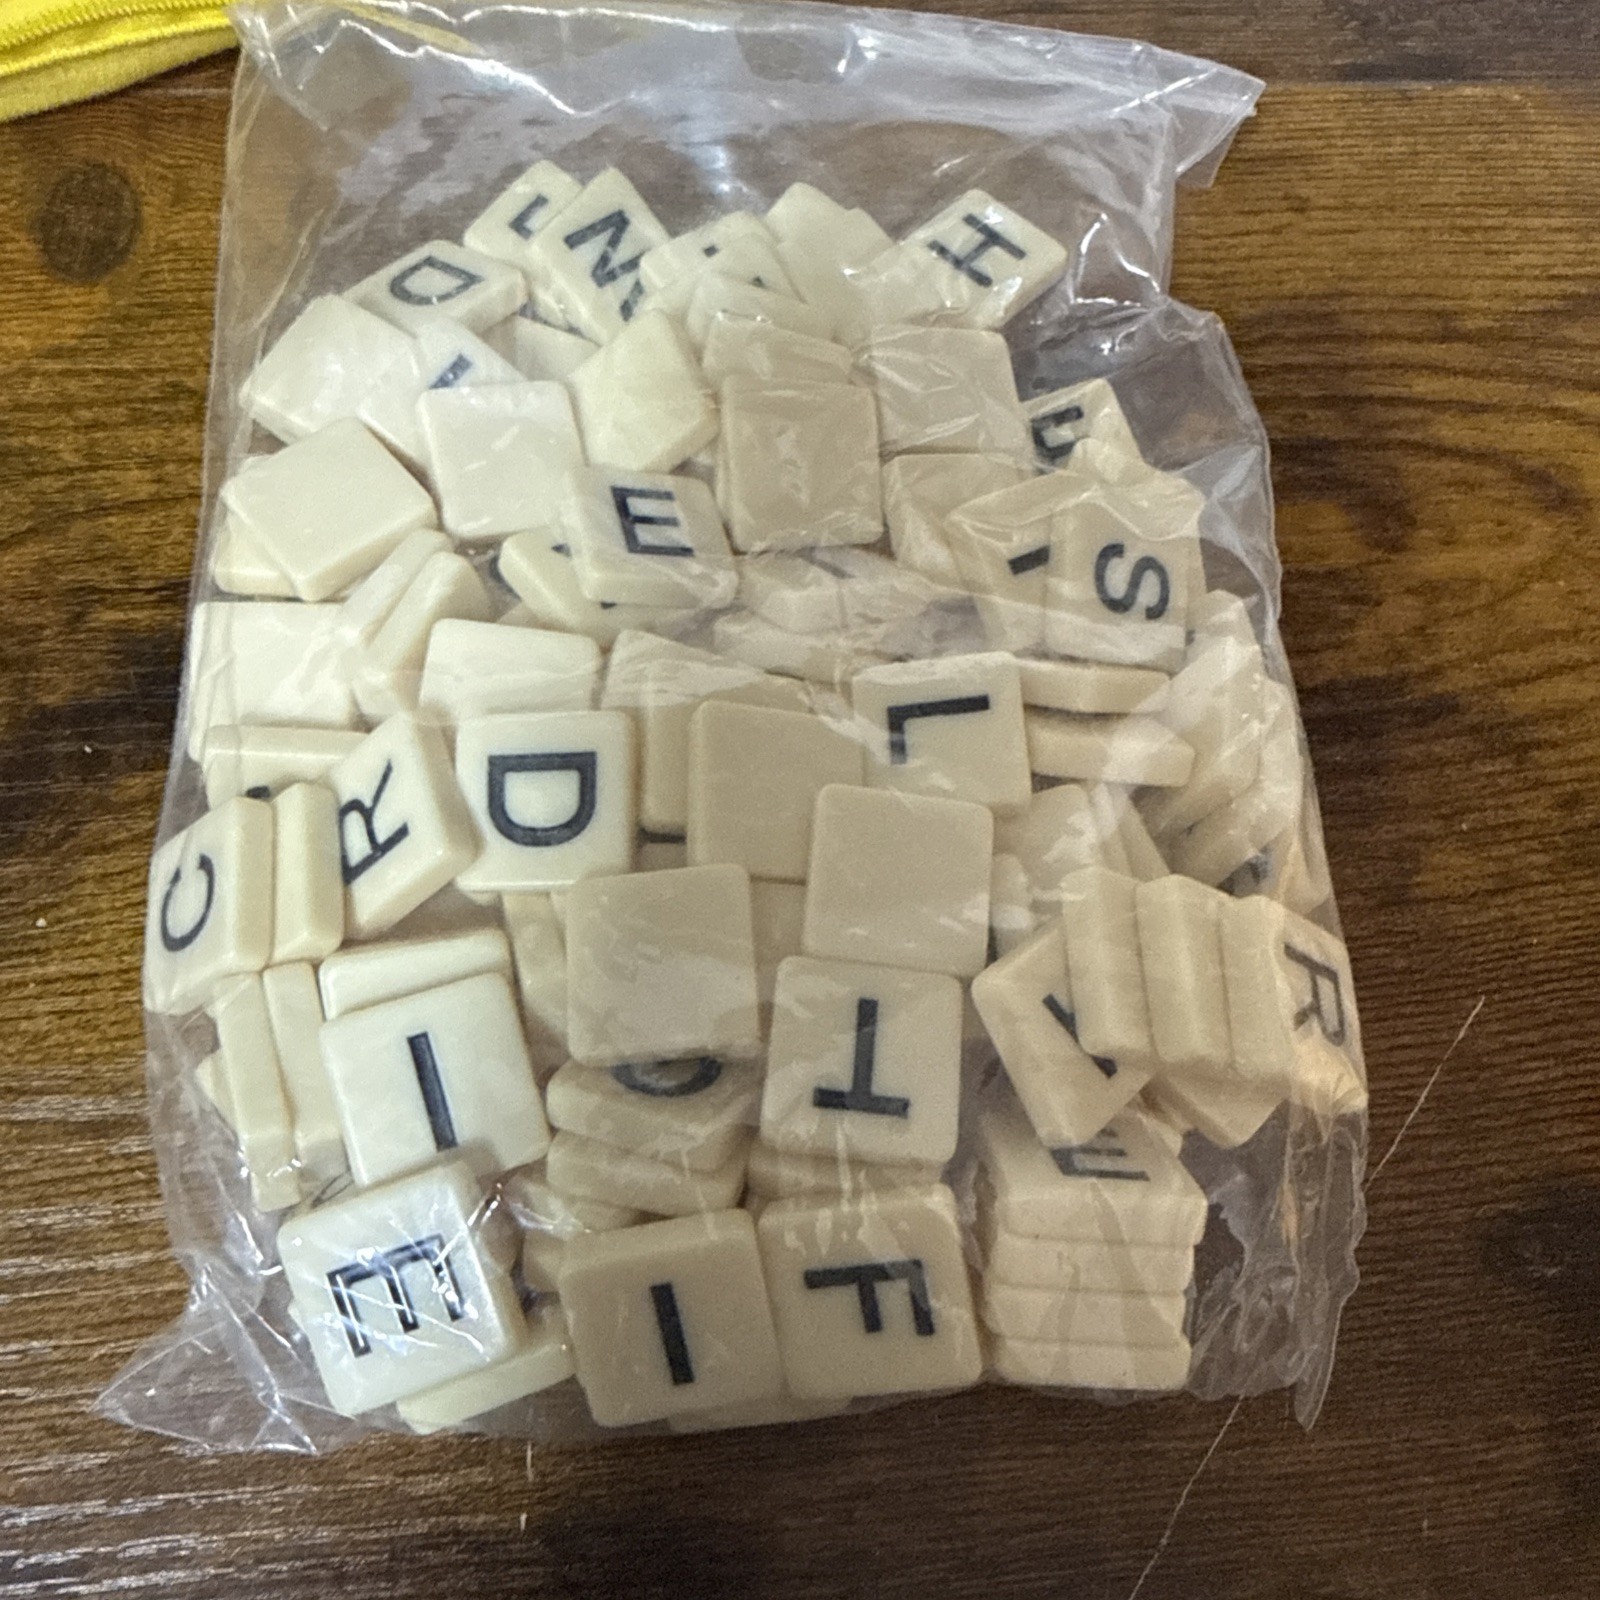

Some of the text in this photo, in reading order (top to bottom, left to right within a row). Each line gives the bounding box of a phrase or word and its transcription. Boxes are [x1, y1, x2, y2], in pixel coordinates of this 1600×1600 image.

[389, 255, 485, 306] D
[928, 213, 1026, 288] H
[612, 485, 695, 557] E
[1095, 542, 1169, 619] S
[887, 694, 990, 765] L
[338, 759, 410, 885] R
[488, 751, 597, 847] D
[160, 853, 214, 952] C
[1284, 942, 1345, 1046] R
[407, 1031, 457, 1152] I
[812, 997, 910, 1119] T
[326, 1233, 464, 1357] E
[650, 1282, 695, 1386] I
[804, 1258, 936, 1336] F
